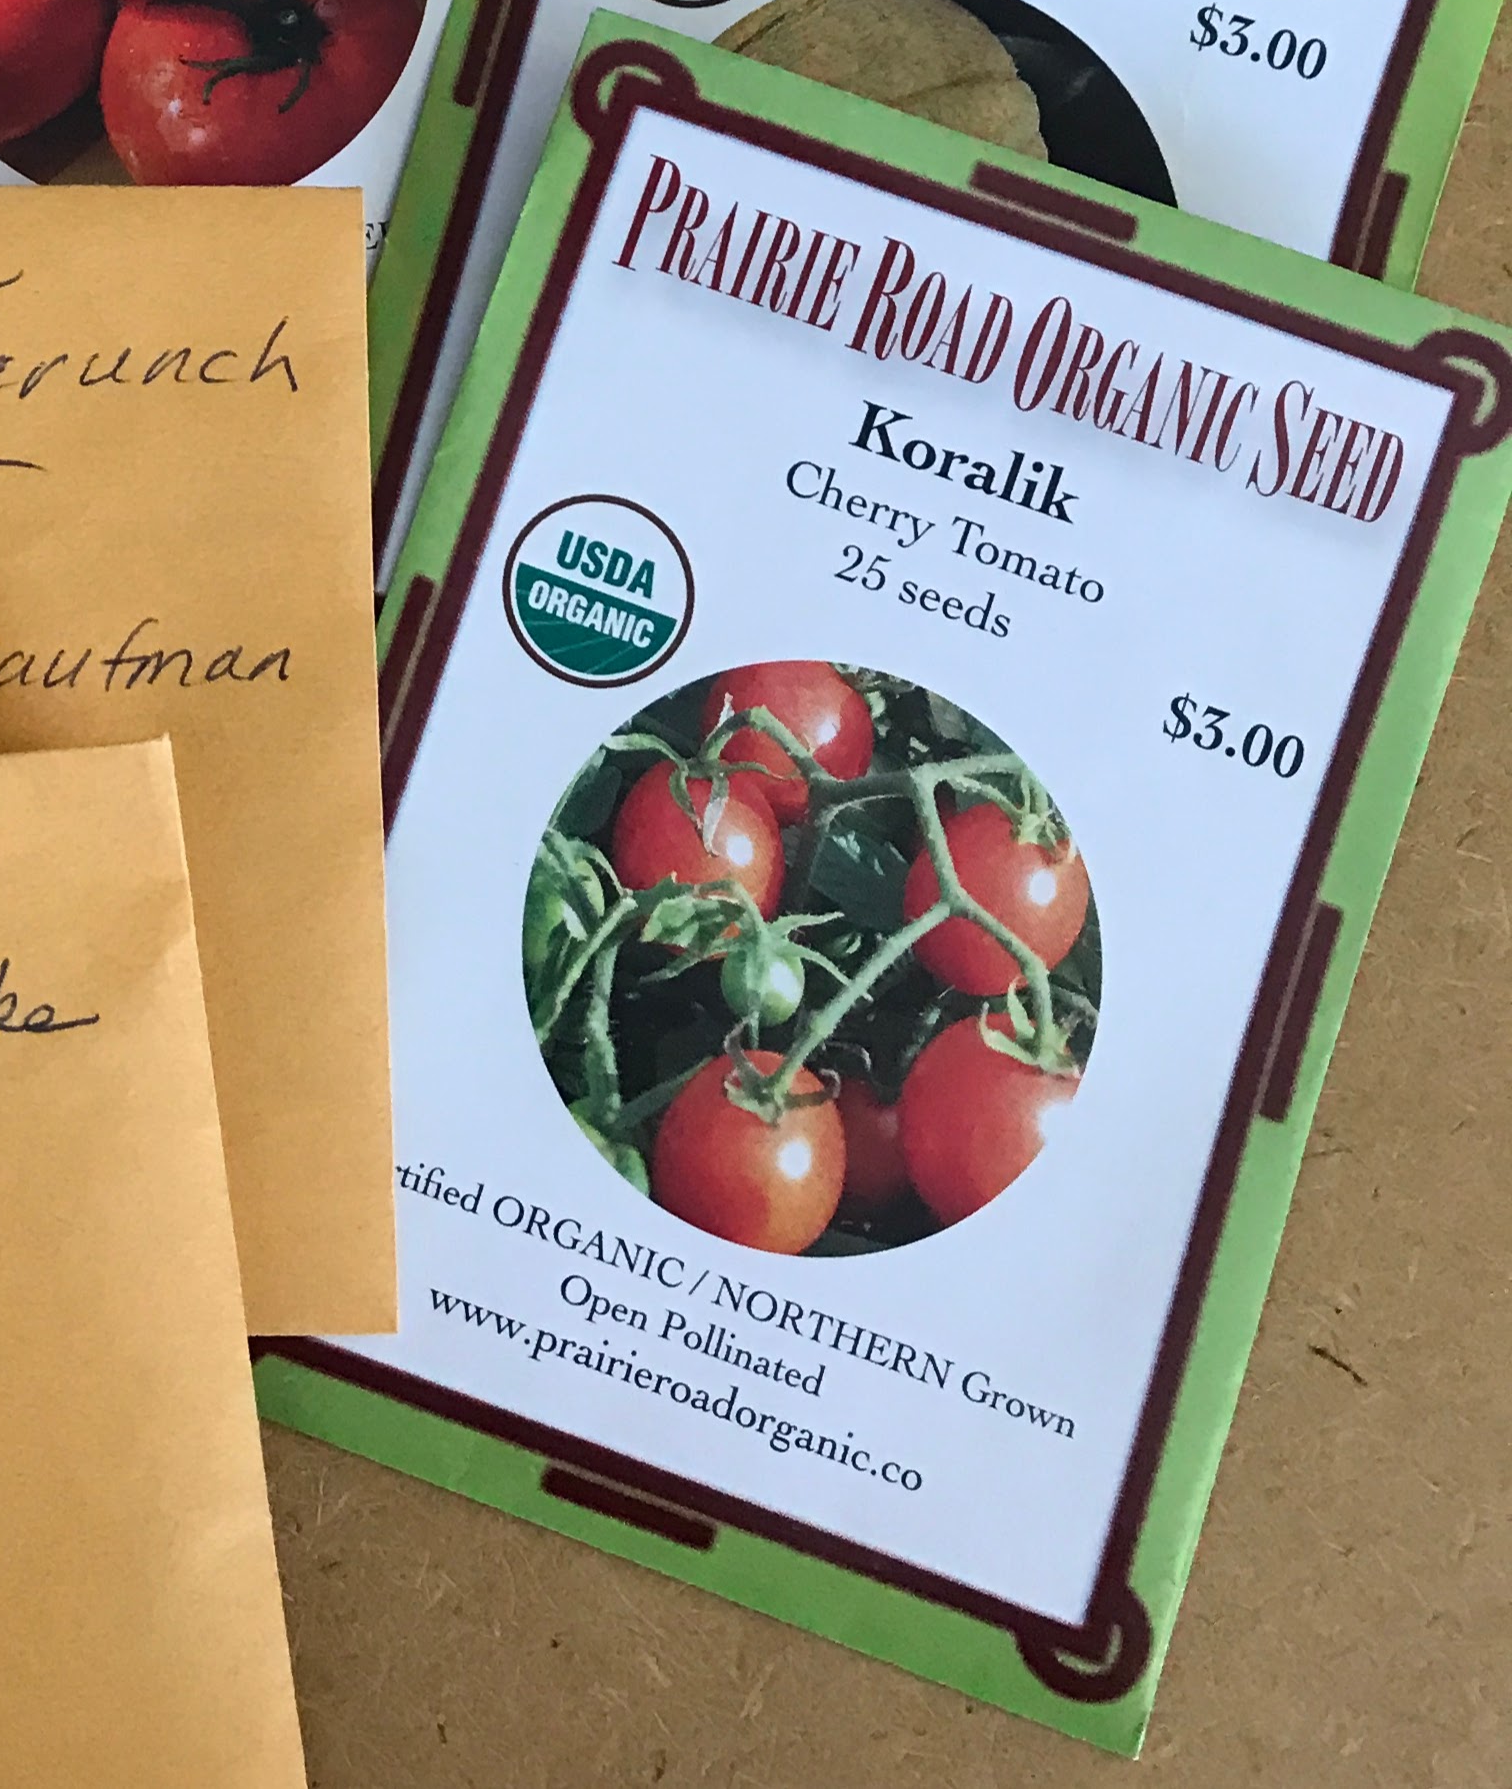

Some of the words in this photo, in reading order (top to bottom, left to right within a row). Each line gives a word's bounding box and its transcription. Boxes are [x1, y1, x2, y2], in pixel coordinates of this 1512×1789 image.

[1189, 4, 1328, 82] $3.00
[612, 154, 861, 332] PRAIRIE
[844, 235, 1015, 385] ROAD
[1012, 296, 1260, 473] ORGANIC
[1246, 379, 1405, 525] SEED
[850, 399, 1080, 525] Koralik
[555, 530, 656, 598] USDA
[784, 460, 935, 548] Cherry
[954, 520, 1106, 605] Tomato
[833, 543, 887, 592] 25
[899, 579, 1012, 640] seeds
[527, 581, 656, 649] ORGANIC
[1162, 691, 1306, 780] $3.00
[395, 1162, 484, 1214] tified
[492, 1196, 686, 1289] ORGANIC
[714, 1276, 955, 1391] NORTHERN
[962, 1372, 1076, 1439] Grown
[560, 1274, 648, 1333] Open
[659, 1315, 825, 1398] Pollinated
[429, 1287, 923, 1493] www.prairieroadorganic.co
